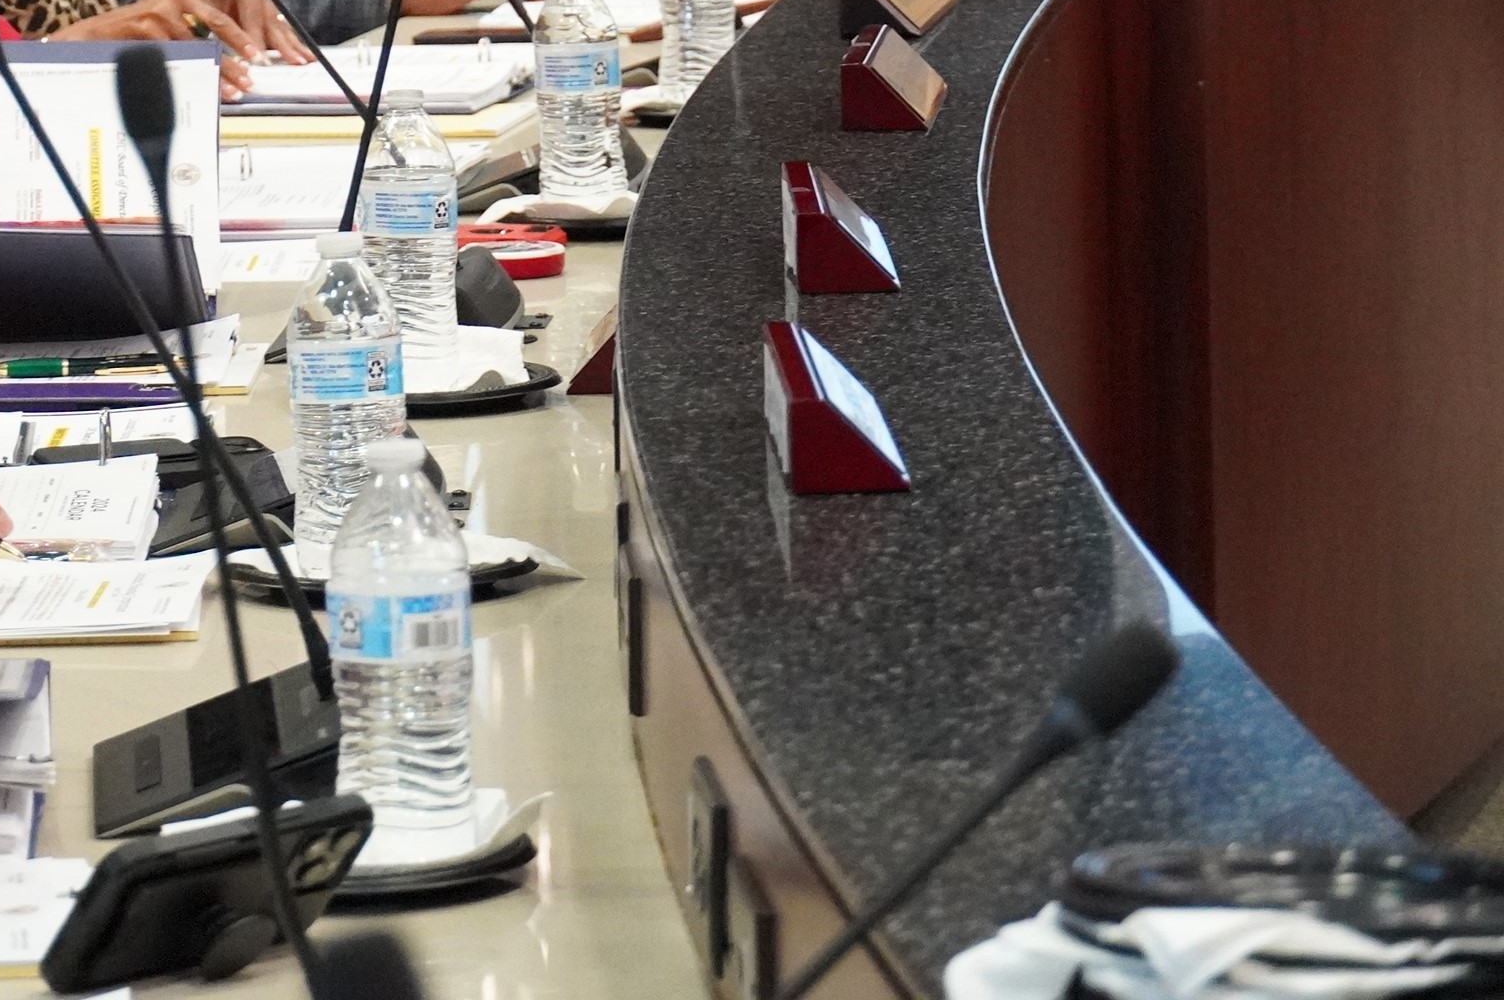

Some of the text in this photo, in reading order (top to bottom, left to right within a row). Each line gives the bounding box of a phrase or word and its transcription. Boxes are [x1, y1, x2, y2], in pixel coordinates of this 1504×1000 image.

[90, 130, 101, 218] COMMITTEE ASSIGNME
[117, 153, 128, 177] Board
[115, 179, 129, 190] of
[118, 190, 128, 218] Direct
[66, 489, 91, 521] CALENDAR
[91, 498, 110, 512] 2024
